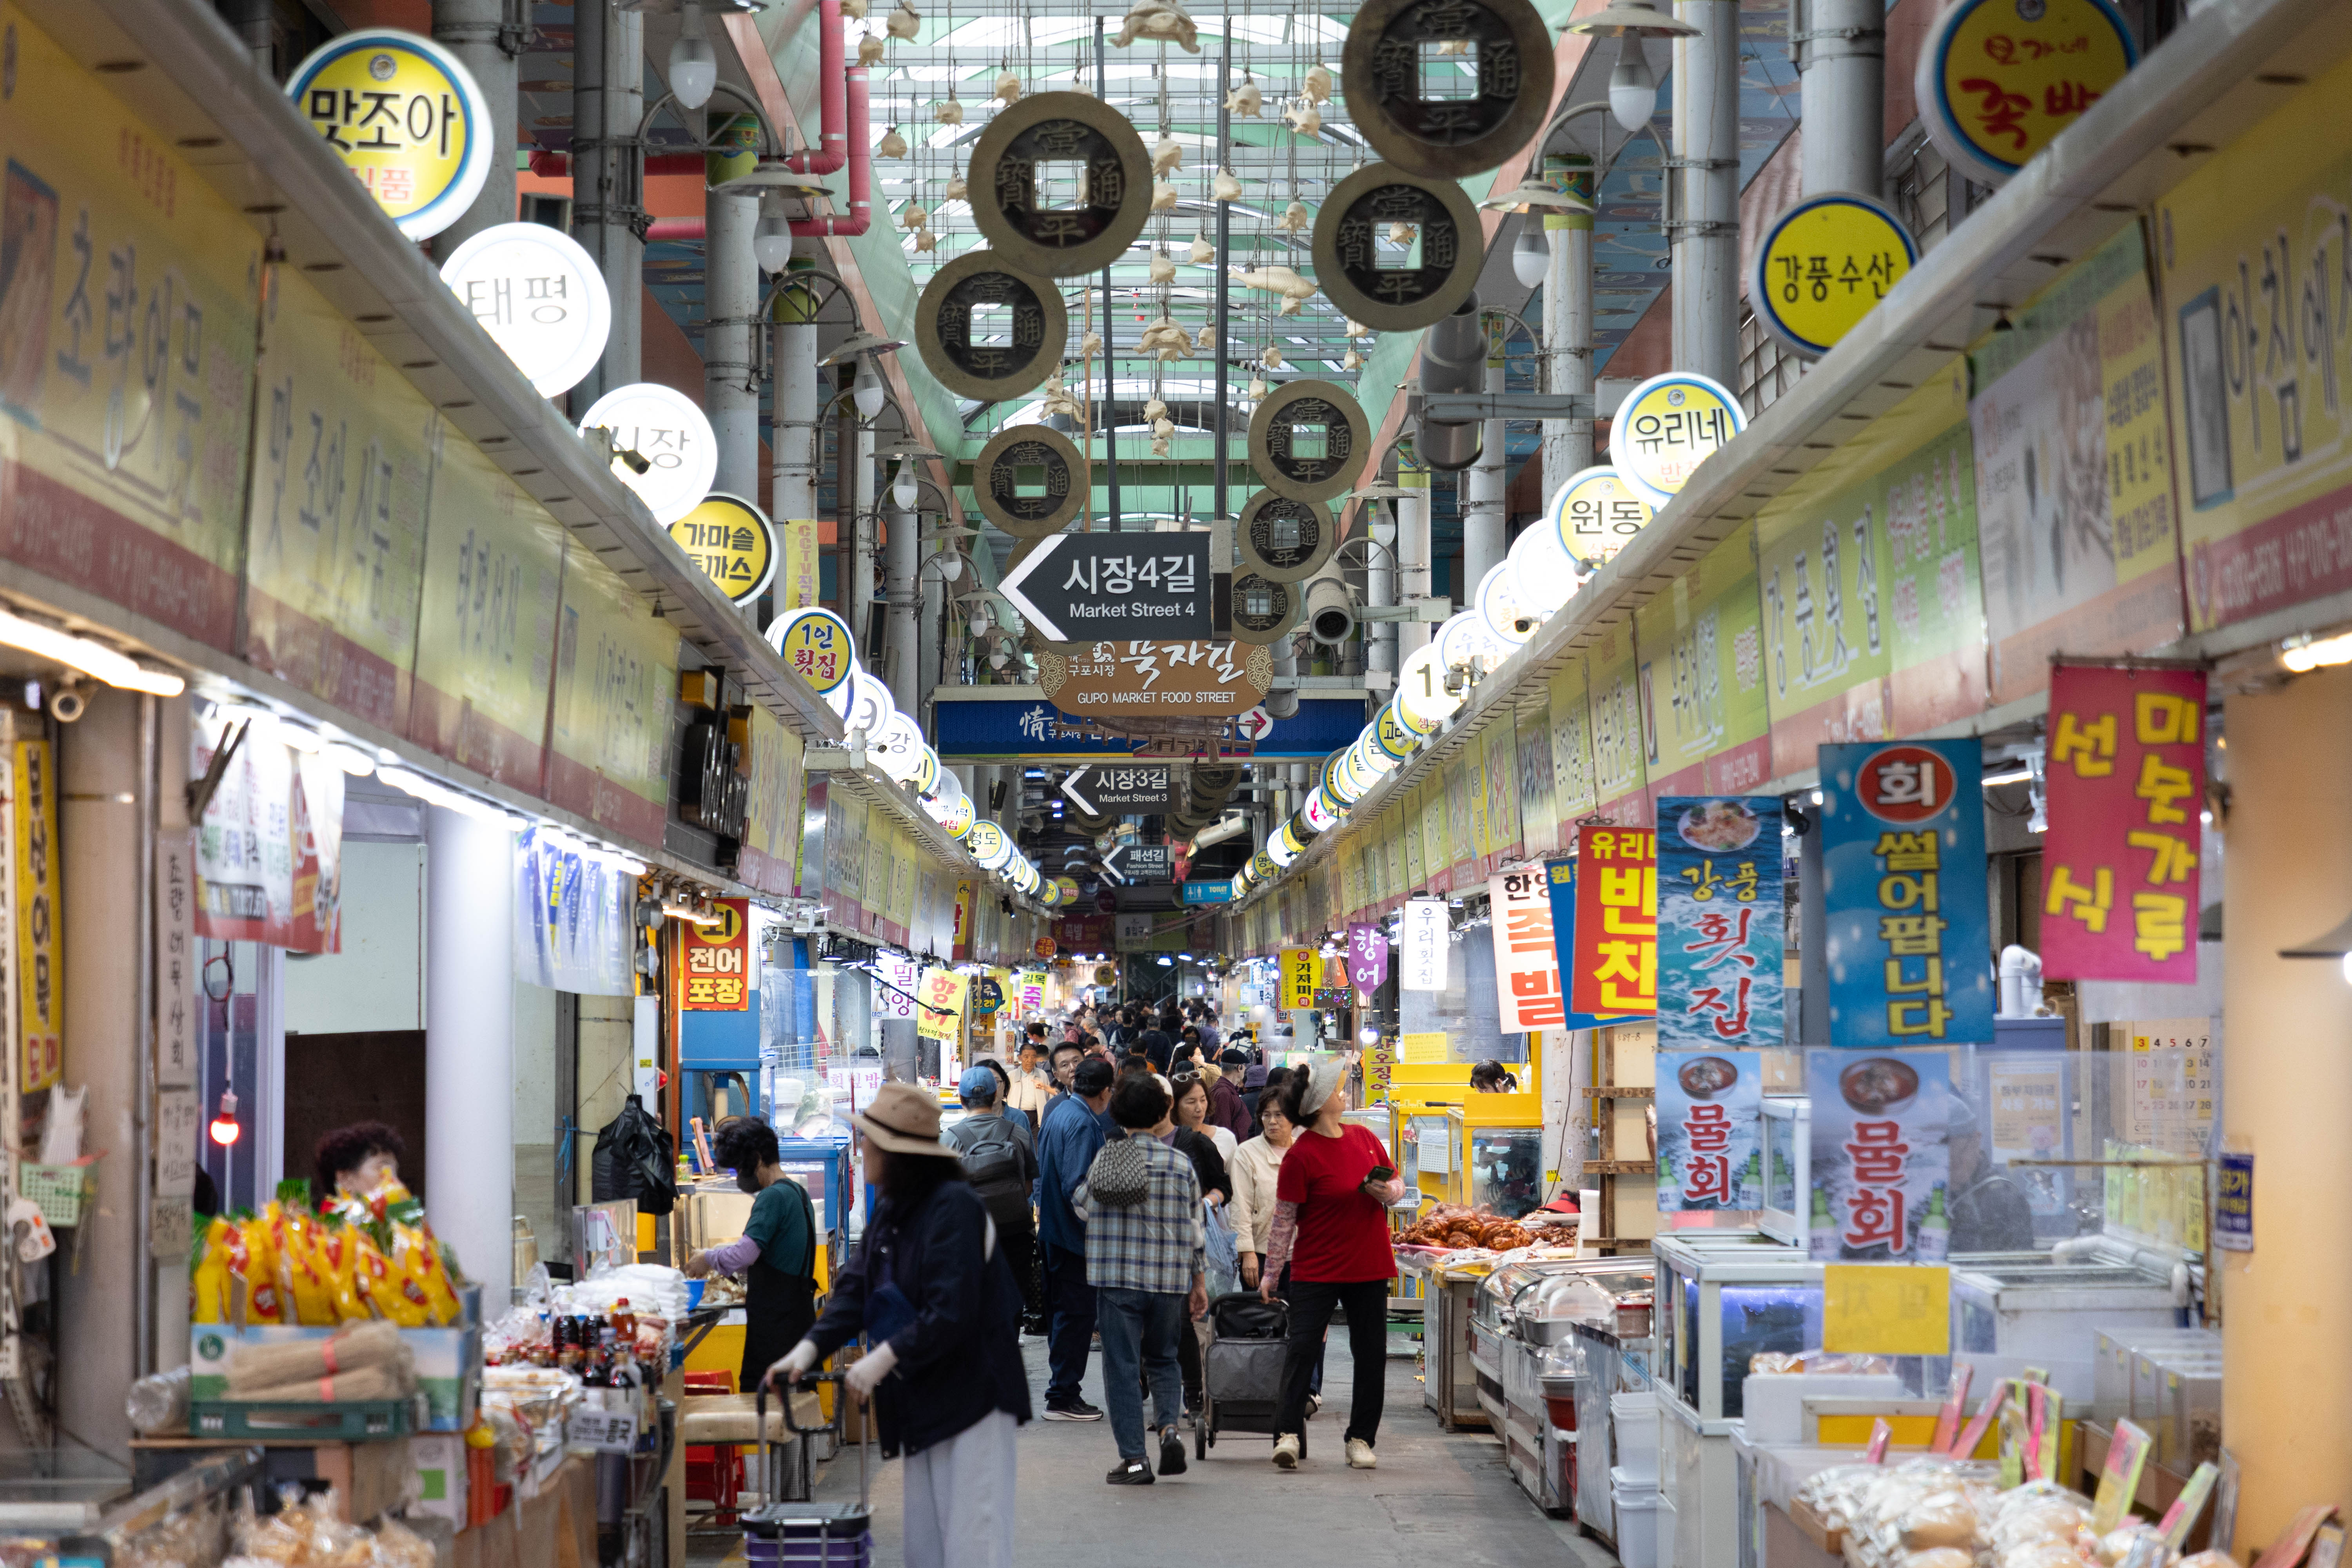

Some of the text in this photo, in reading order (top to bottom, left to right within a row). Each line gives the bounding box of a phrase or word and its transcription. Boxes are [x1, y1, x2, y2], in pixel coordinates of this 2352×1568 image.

[310, 89, 457, 157] 맛조아
[1773, 253, 1895, 304] 강풍수산
[466, 274, 567, 325] 태평
[1635, 407, 1727, 455] 유리네
[1570, 500, 1643, 535] 원동
[1062, 555, 1195, 594] 시장4길
[1070, 602, 1195, 618] Market Street 4
[802, 623, 833, 650] 1인
[794, 649, 837, 681] 횟집
[1068, 665, 1116, 677] 구포시장
[1078, 691, 1236, 704] GUPO MARKET FOOD STREET
[1019, 705, 1054, 742] 情
[1095, 768, 1167, 790] 시장3길
[1099, 793, 1167, 802] Market Street 3
[1876, 760, 1936, 808] 회
[2045, 711, 2117, 933] 선식
[2127, 691, 2199, 961] 미숫가루
[1130, 849, 1164, 862] 패션길
[1681, 859, 1759, 902] 강풍
[689, 947, 742, 973] 전어
[1353, 928, 1388, 987] 향어
[1417, 907, 1436, 985] 우리횟집
[688, 978, 743, 1003] 포장
[1023, 974, 1045, 985] 길목
[1296, 963, 1311, 995] 가자미
[1684, 907, 1756, 1040] 횟집
[1023, 986, 1042, 1010] 죽
[1682, 1103, 1731, 1205] 물회
[1844, 1120, 1910, 1253] 물회
